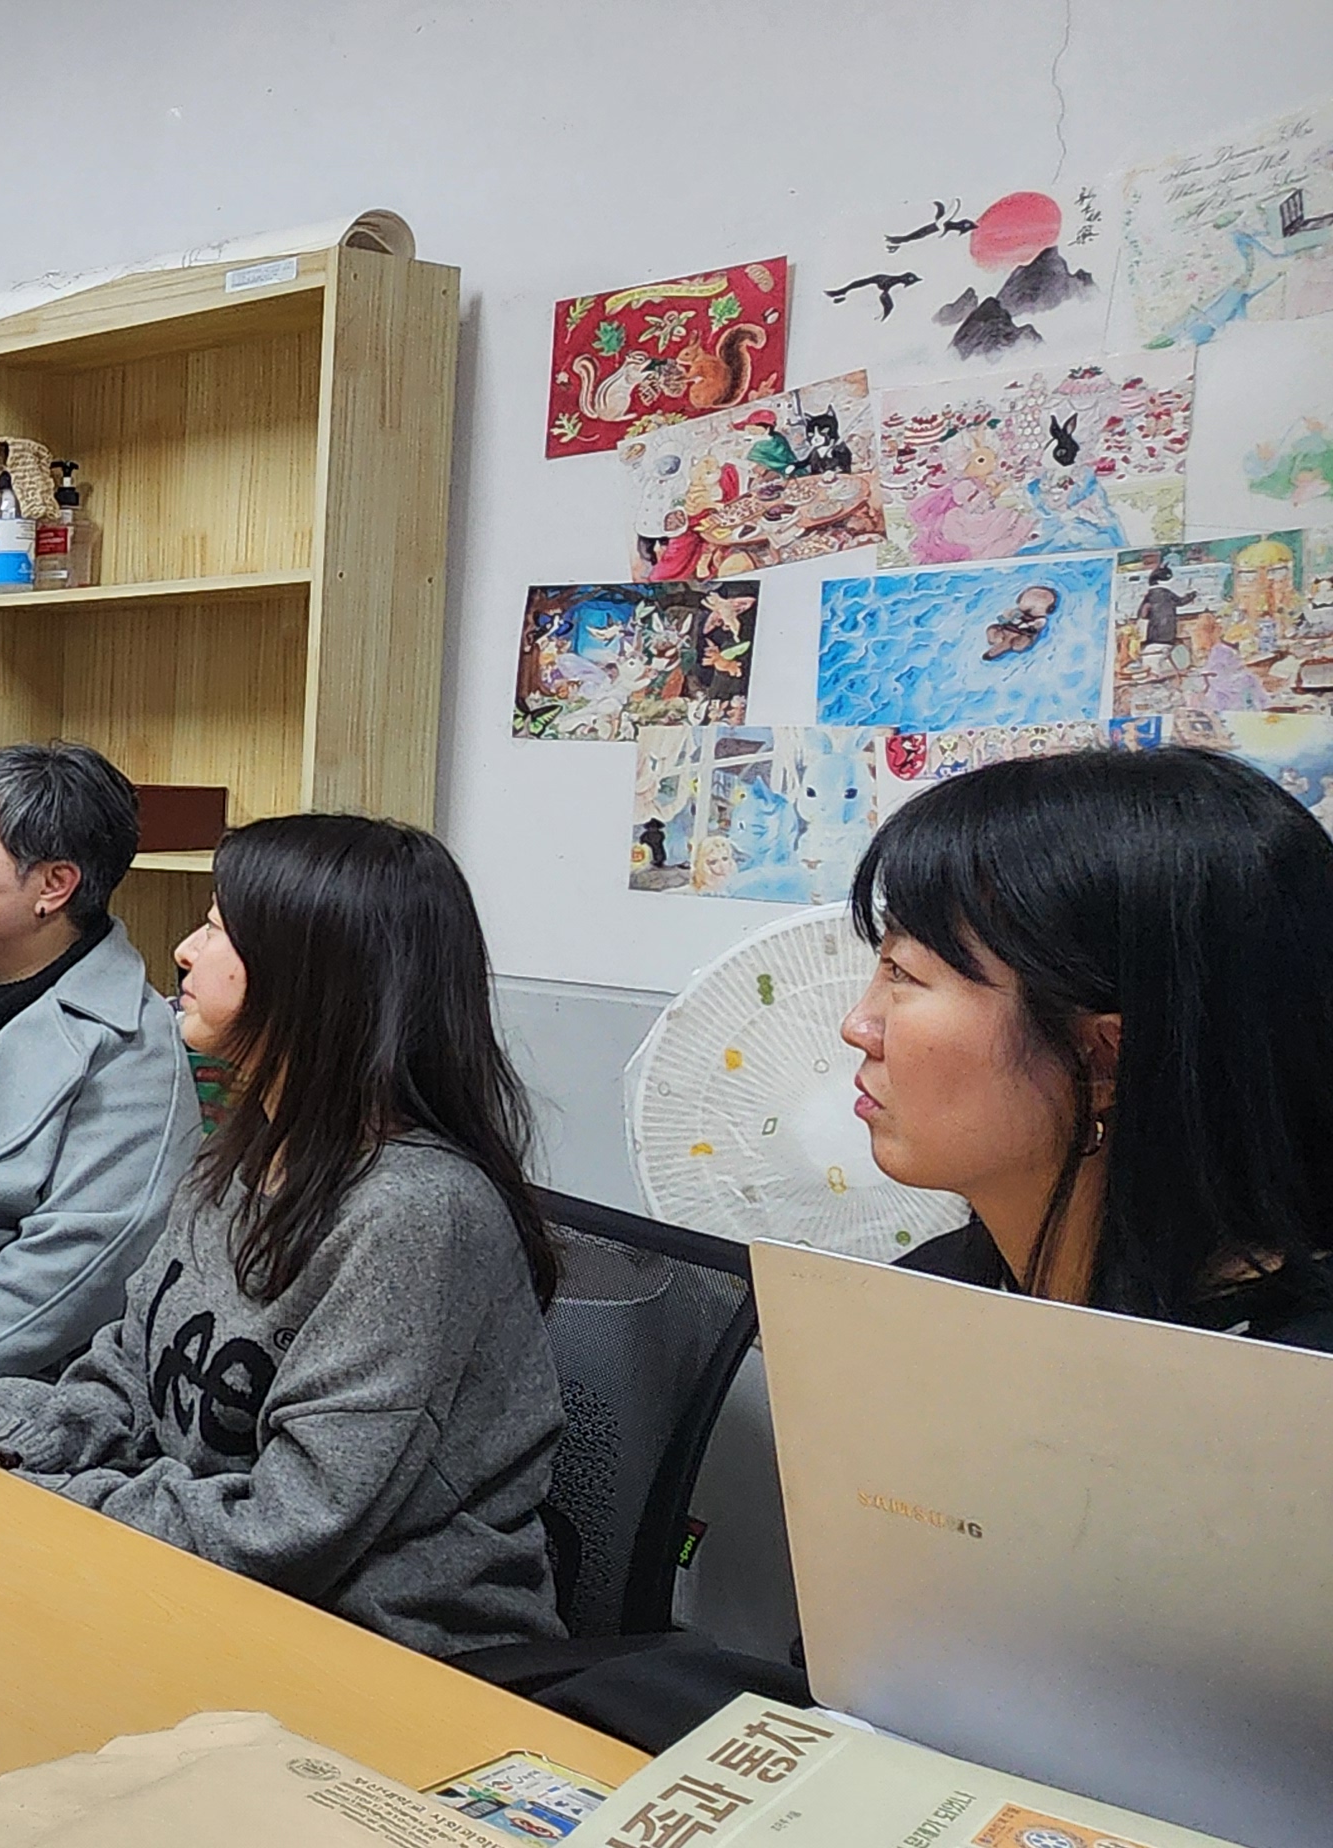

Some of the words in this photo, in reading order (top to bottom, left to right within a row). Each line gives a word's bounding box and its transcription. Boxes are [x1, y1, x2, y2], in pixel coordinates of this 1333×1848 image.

[145, 1257, 278, 1456] Lee
[430, 1813, 505, 1848] 사회과학
[606, 1774, 754, 1848] 족과
[705, 1710, 835, 1784] 통치
